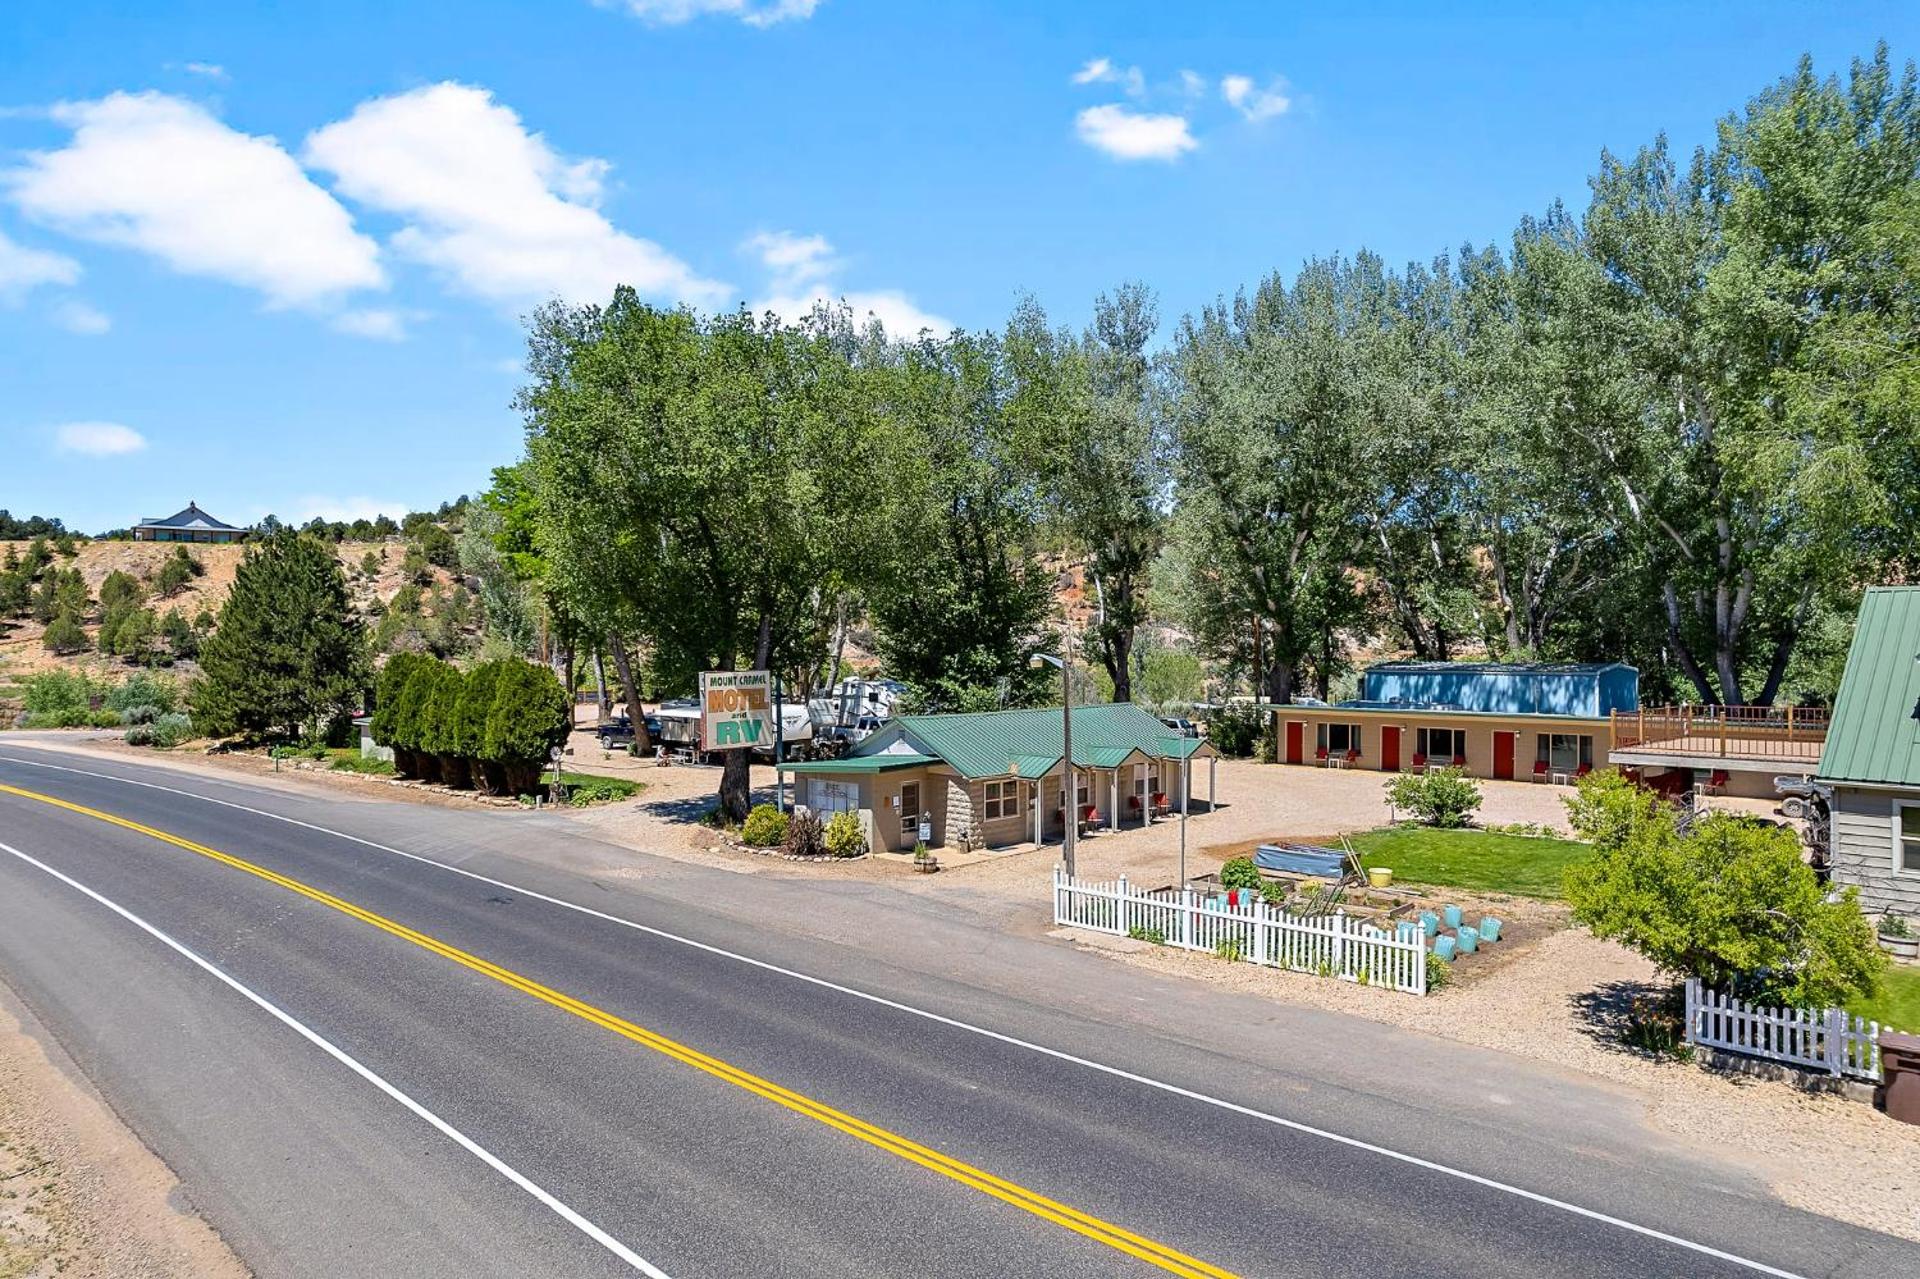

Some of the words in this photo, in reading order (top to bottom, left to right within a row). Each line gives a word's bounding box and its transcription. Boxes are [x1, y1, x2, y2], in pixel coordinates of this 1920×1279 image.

[710, 676, 737, 687] MOUNT
[739, 674, 767, 685] CARMEL
[708, 688, 769, 713] MOTEL
[716, 719, 763, 745] RV
